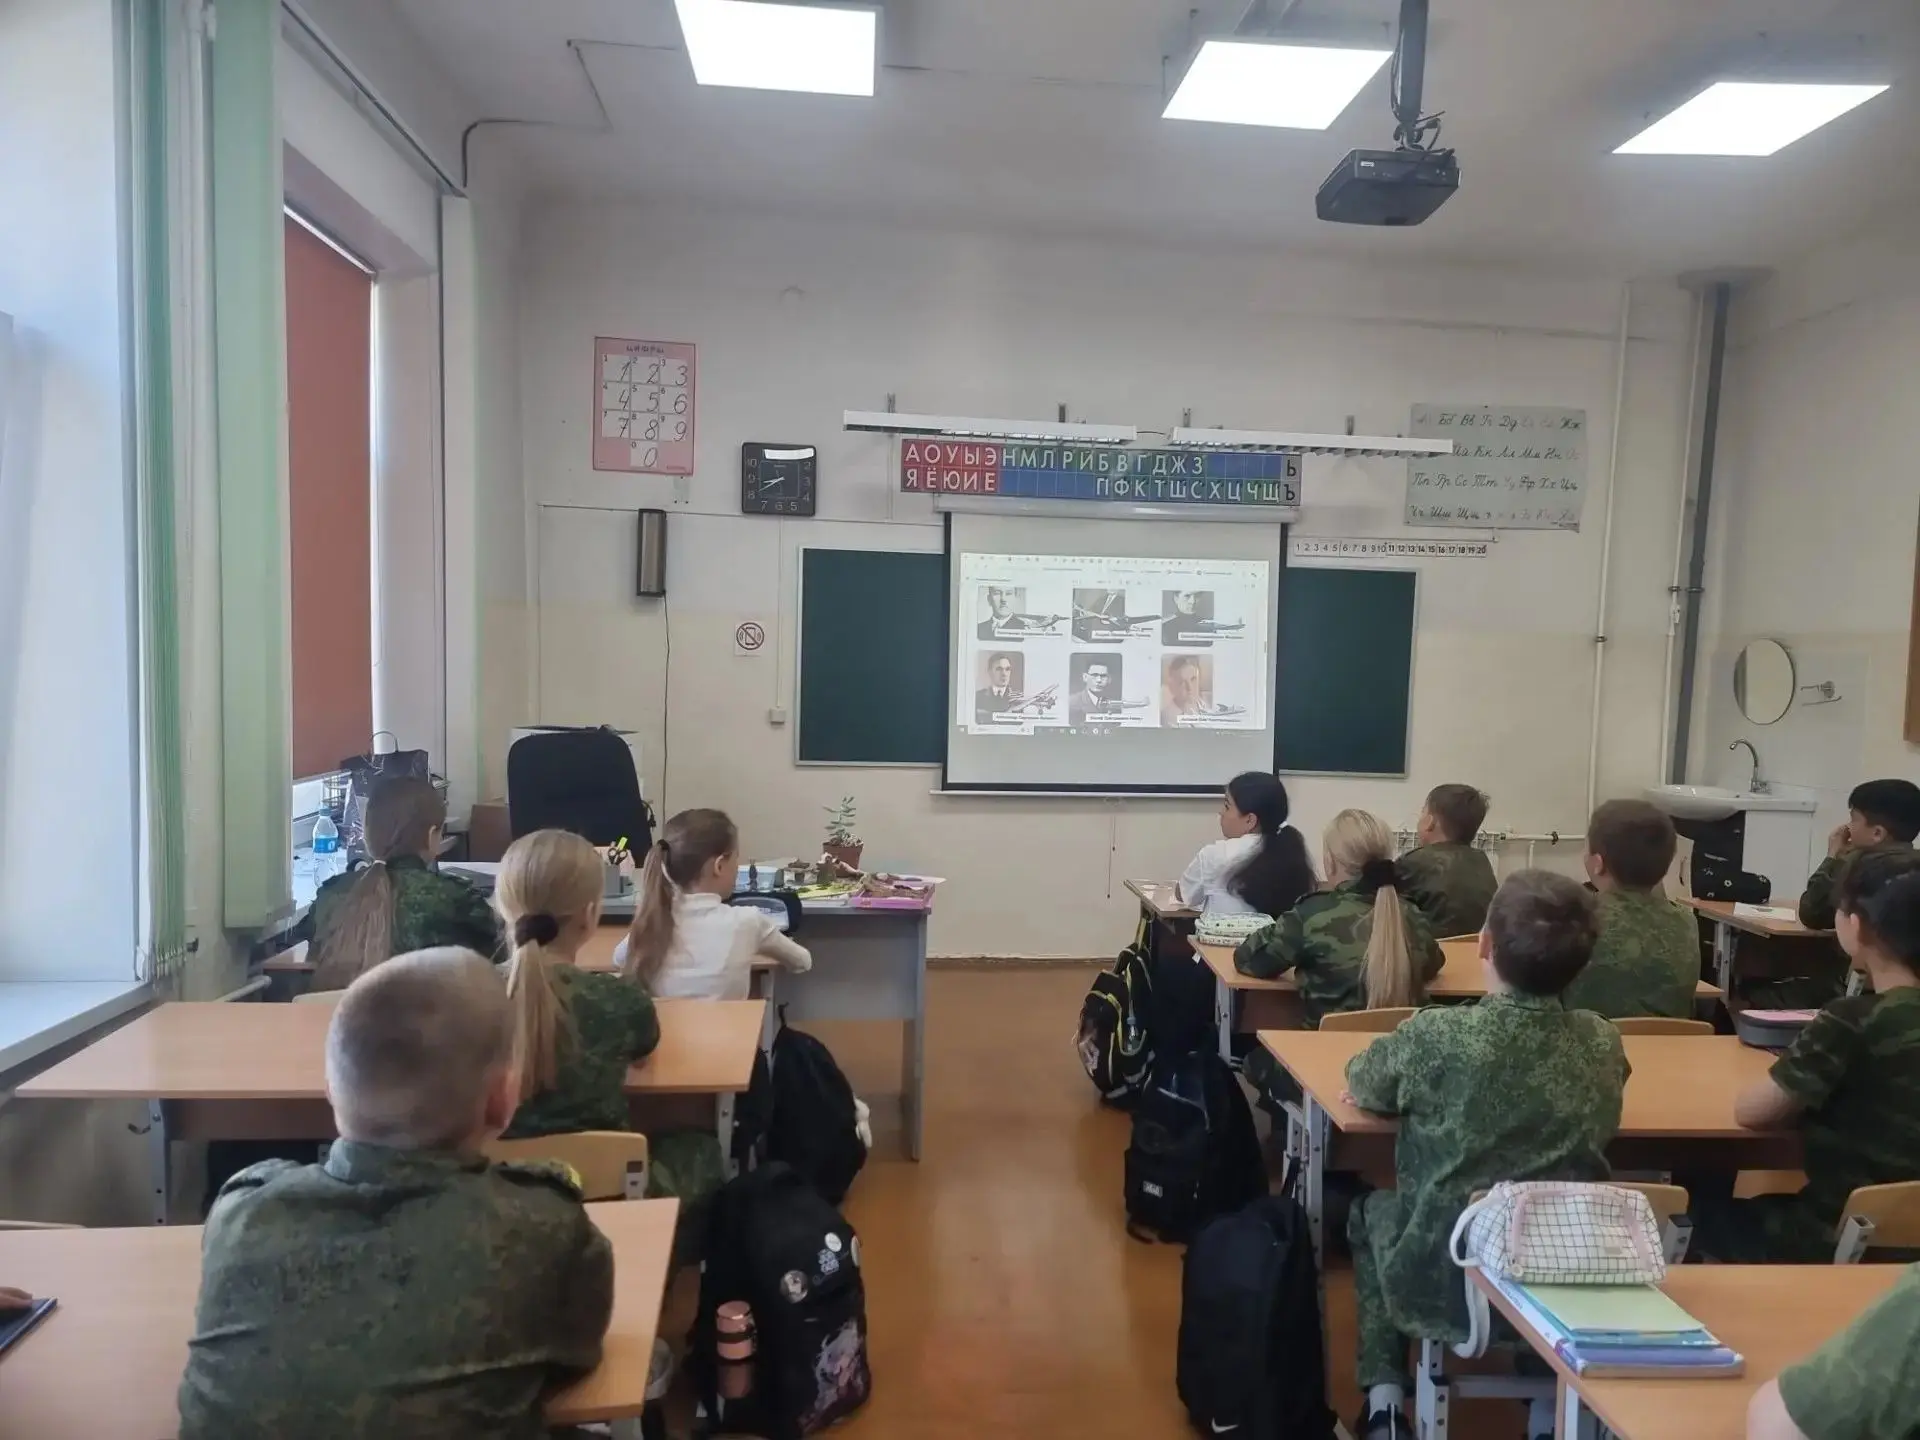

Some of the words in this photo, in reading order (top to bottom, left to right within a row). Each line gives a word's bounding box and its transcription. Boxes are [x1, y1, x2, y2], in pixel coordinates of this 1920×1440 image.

[905, 444, 920, 463] А
[924, 444, 941, 463] О
[946, 446, 960, 464] У
[965, 447, 980, 465] Ы
[984, 448, 997, 466] Э
[1002, 449, 1015, 467] Н
[1020, 449, 1036, 468] М
[1041, 450, 1054, 468] Л
[1062, 451, 1073, 469] Р
[1080, 450, 1093, 471] Й
[1099, 454, 1108, 472] Б
[1117, 454, 1128, 472] В
[1137, 455, 1147, 472] Г
[1152, 455, 1167, 475] Д
[1171, 456, 1186, 474] Ж
[1192, 456, 1203, 474] З
[1287, 460, 1296, 476] Ь
[906, 469, 918, 487] Я
[926, 467, 937, 488] Ё
[943, 470, 960, 489] Ю
[964, 472, 978, 491] И
[985, 473, 996, 491] Е
[1096, 478, 1109, 495] П
[1114, 478, 1129, 496] Ф
[1135, 479, 1146, 496] К
[1155, 480, 1167, 497] Т
[1169, 480, 1187, 498] Ш
[1191, 480, 1202, 499] С
[1209, 481, 1223, 499] Х
[1228, 482, 1241, 501] Ц
[1247, 482, 1258, 500] Ч
[1263, 482, 1279, 503] Щ
[1284, 484, 1295, 501] Ъ
